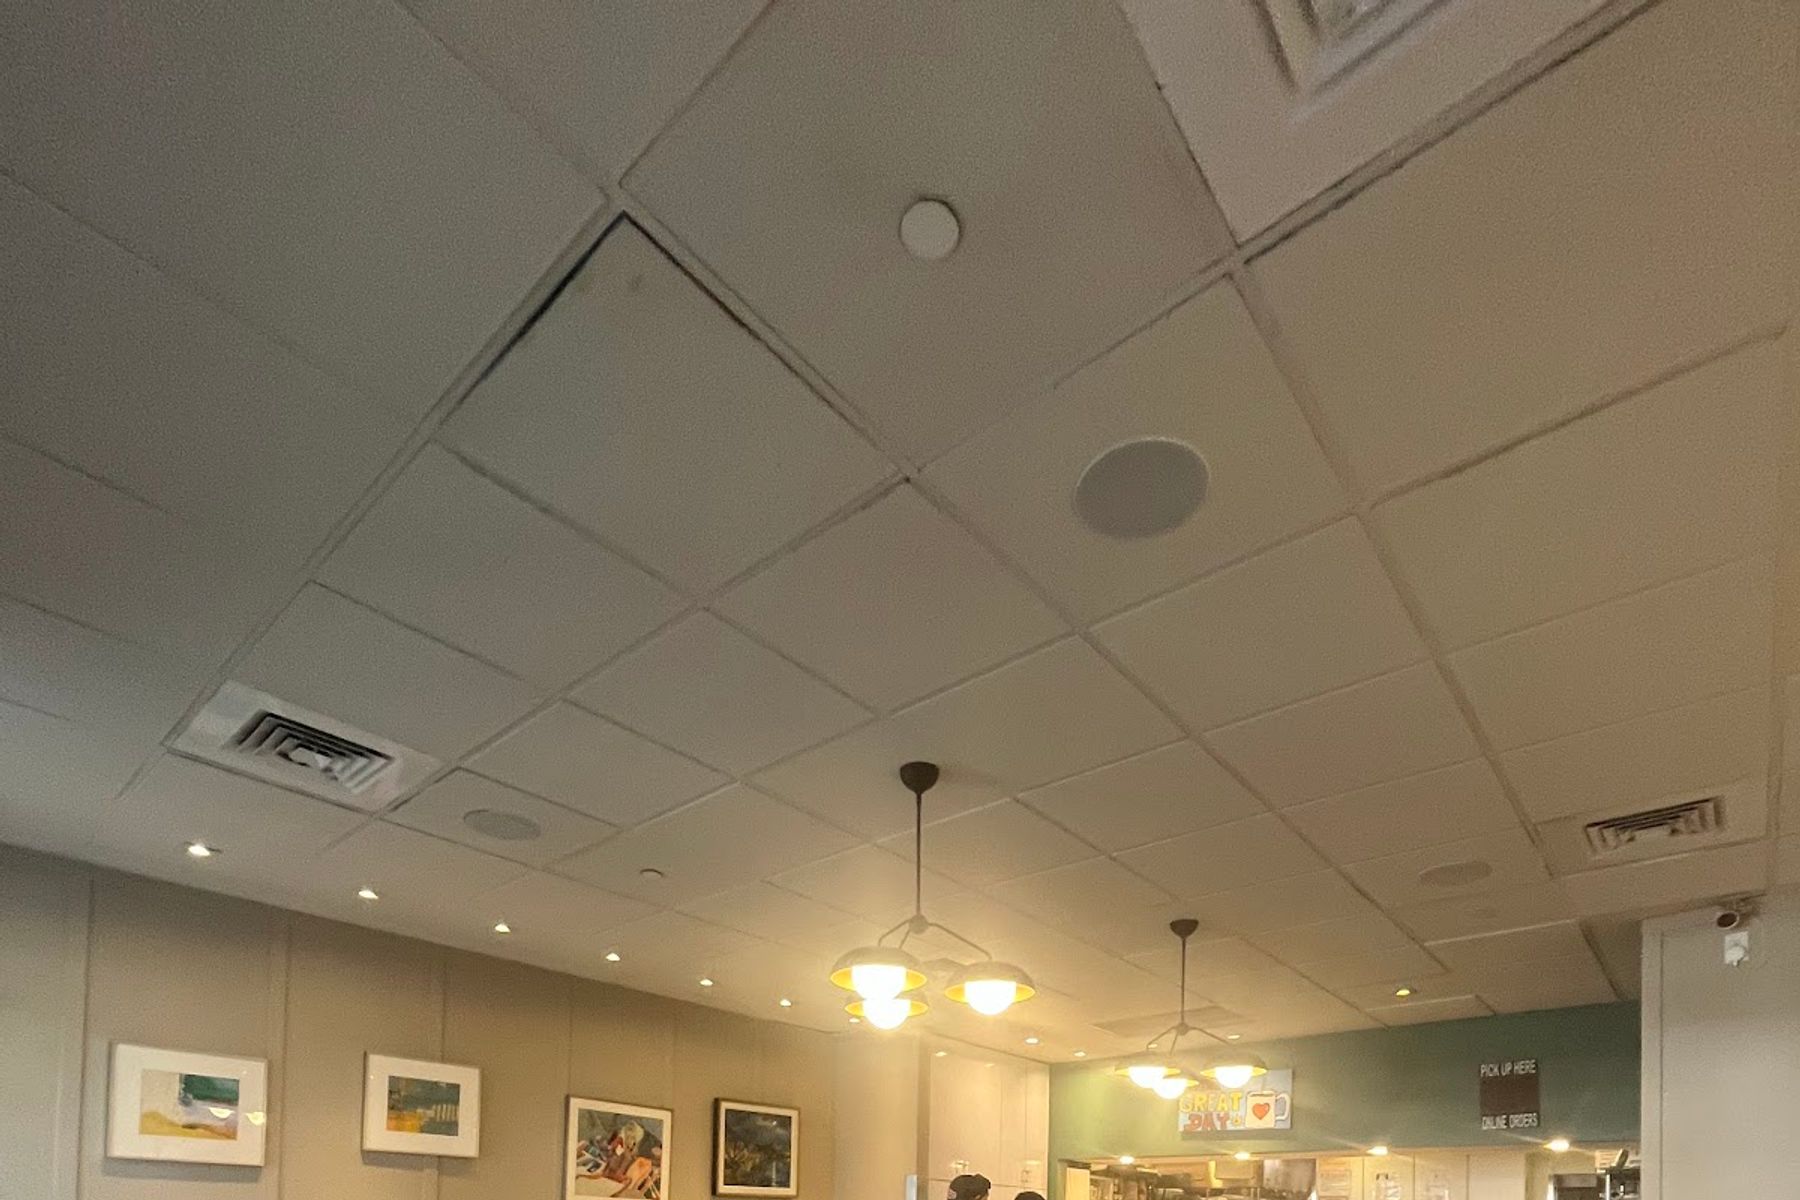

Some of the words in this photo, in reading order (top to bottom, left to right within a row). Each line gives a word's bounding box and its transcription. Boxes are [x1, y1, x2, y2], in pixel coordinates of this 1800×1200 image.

[1481, 1063, 1499, 1077] PICK
[1501, 1062, 1512, 1076] UP
[1514, 1060, 1536, 1074] HERE
[1179, 1091, 1242, 1112] GREAT
[1482, 1115, 1507, 1130] ONLINE
[1509, 1113, 1538, 1128] ORDERS
